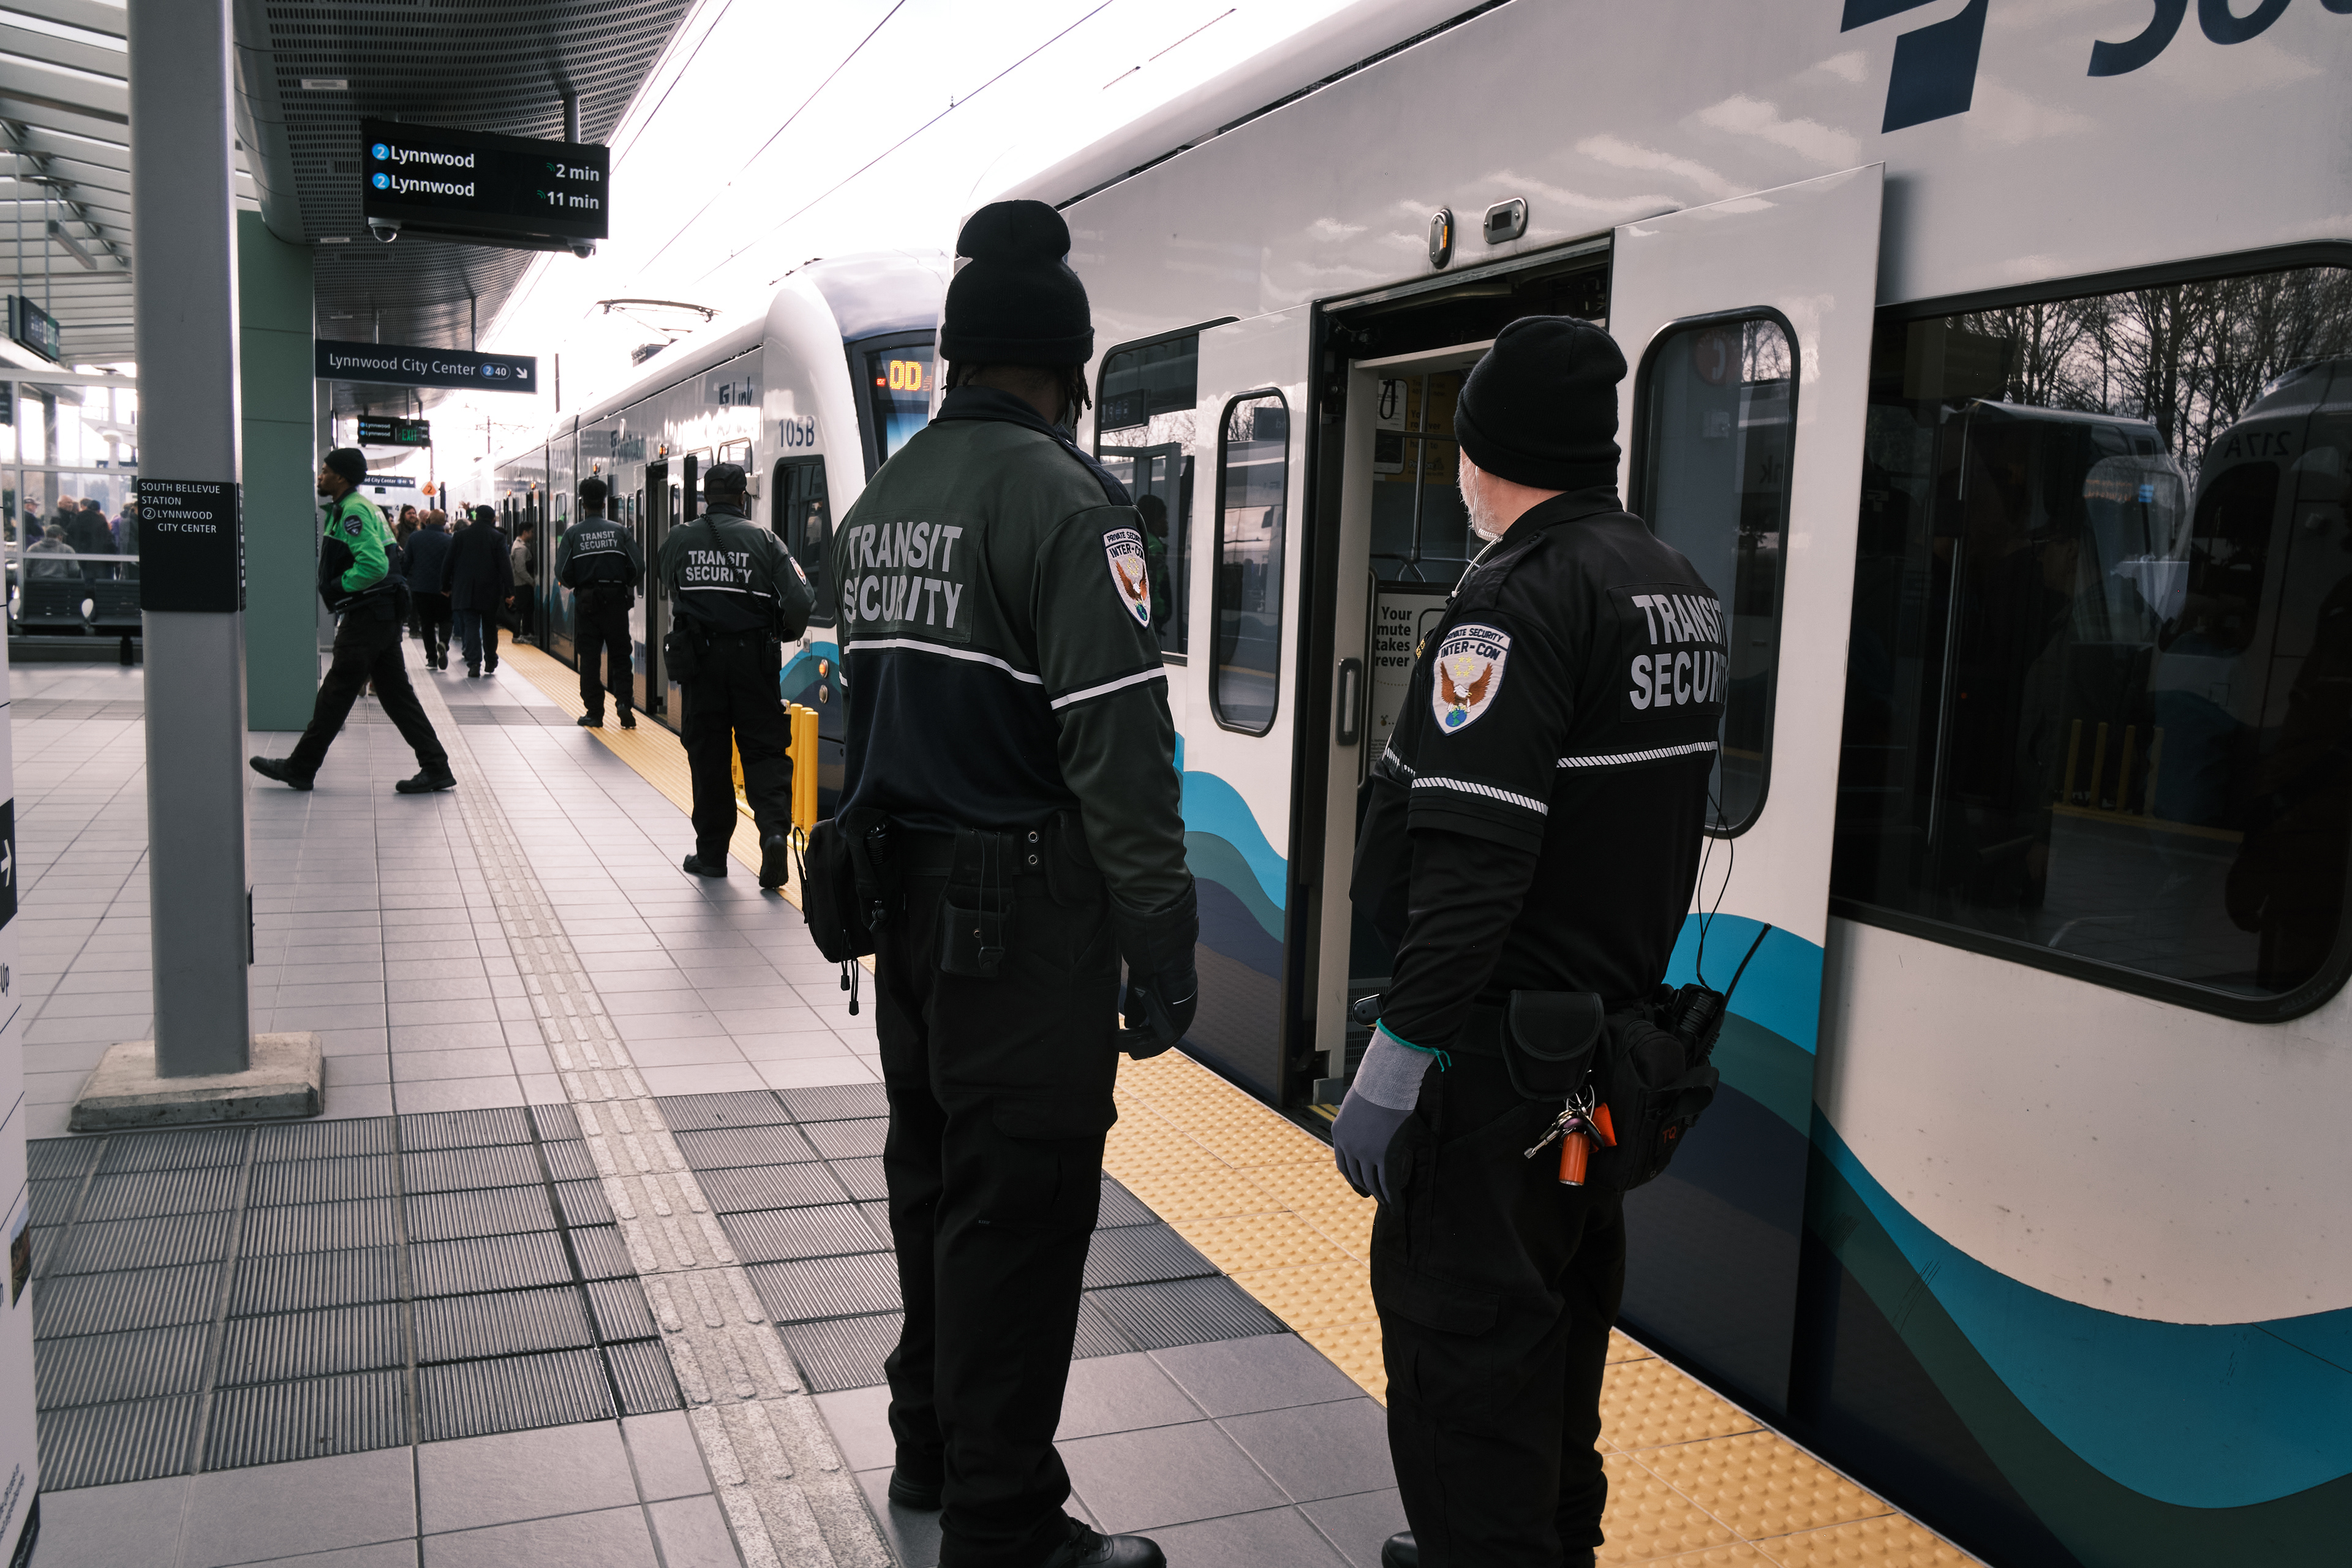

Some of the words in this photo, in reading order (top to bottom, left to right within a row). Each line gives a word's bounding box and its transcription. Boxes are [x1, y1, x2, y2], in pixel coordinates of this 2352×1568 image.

[377, 146, 385, 159] 2
[391, 145, 475, 168] Lynnwood
[556, 164, 566, 178] 2
[570, 165, 600, 182] min
[378, 175, 385, 188] 2
[391, 175, 475, 197] Lynnwood
[547, 191, 564, 206] 11
[569, 193, 600, 209] min
[330, 353, 398, 371] Lynnwood
[402, 358, 428, 375] City
[432, 361, 475, 376] Center
[486, 366, 492, 375] 2
[495, 368, 507, 376] 40
[402, 429, 417, 442] EXIT
[778, 416, 815, 448] 105B
[141, 483, 173, 492] SOUTH
[176, 484, 221, 494] BELLEVUE
[141, 496, 181, 505] STATION
[146, 509, 152, 518] 2
[157, 510, 213, 520] LYNNWOOD
[157, 523, 178, 532] CITY
[181, 524, 217, 533] CENTER
[581, 530, 615, 542] TRANSIT
[1107, 532, 1126, 543] PRIVATE
[579, 539, 617, 551] SECURITY
[848, 522, 963, 573] TRANSIT
[1109, 543, 1144, 560] INTER-CO
[688, 550, 750, 567] TRANSIT
[1382, 606, 1412, 620] Your
[1631, 594, 1726, 647] TRANSIT
[1377, 624, 1411, 636] mute
[1446, 628, 1467, 641] PRIVATE
[1469, 628, 1504, 643] SECURITY
[1376, 638, 1410, 651] takes
[1441, 641, 1501, 660] INTER-CON
[1376, 656, 1409, 667] rever
